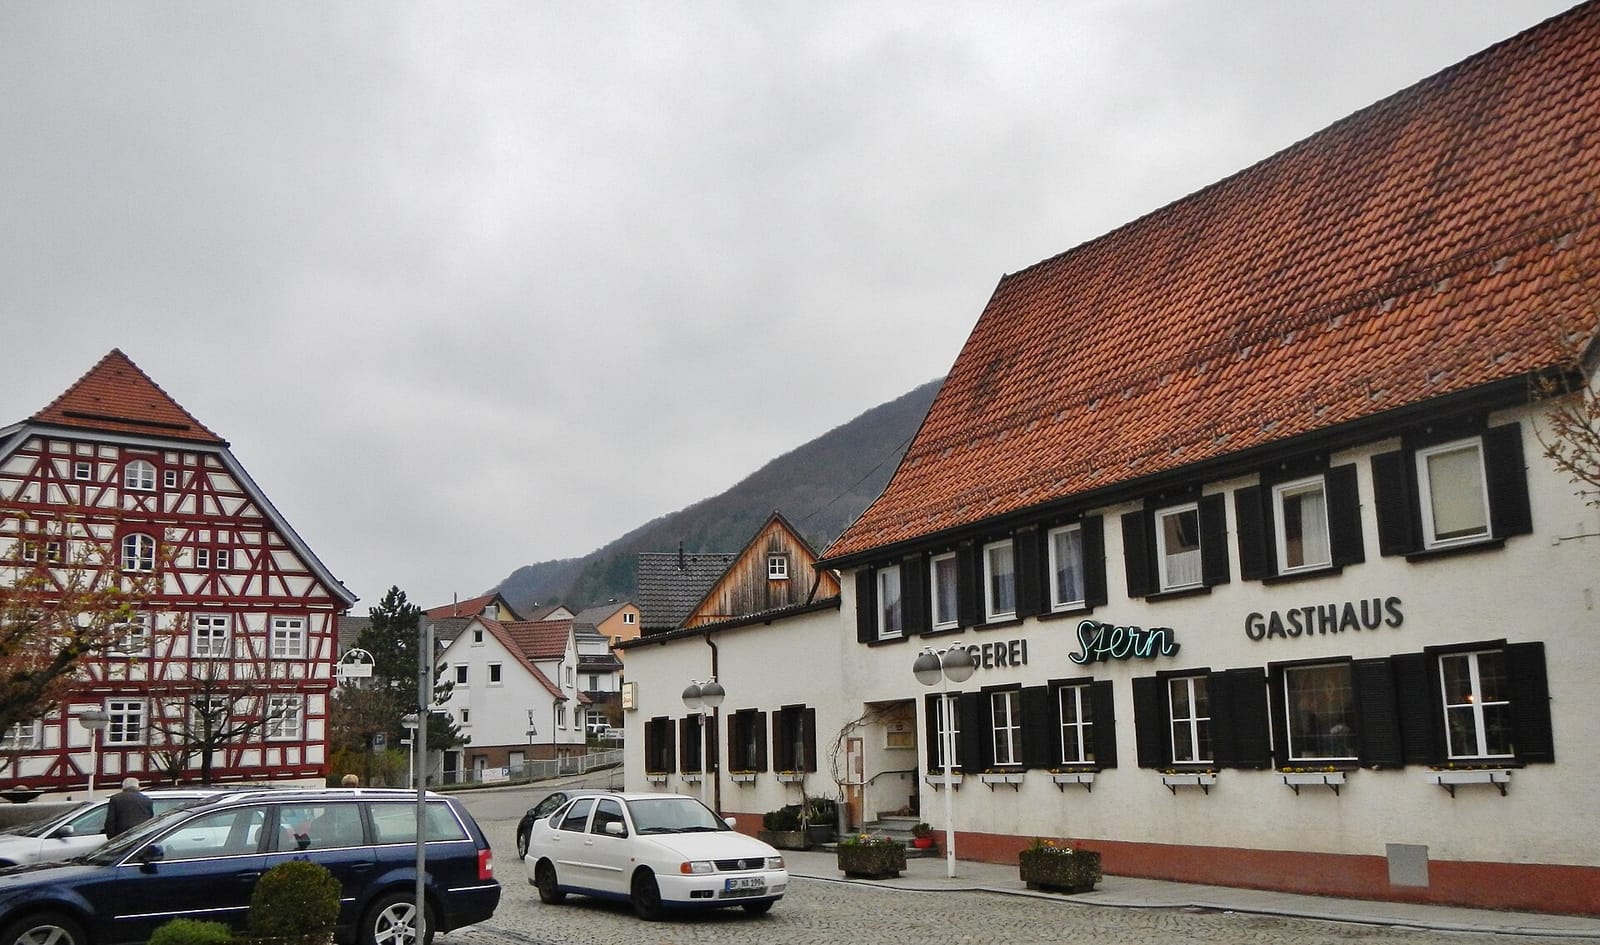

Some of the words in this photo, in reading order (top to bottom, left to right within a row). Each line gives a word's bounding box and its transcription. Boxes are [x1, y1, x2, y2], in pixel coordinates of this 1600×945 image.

[1245, 596, 1404, 641] GASTHAUS
[918, 638, 1028, 671] GEREI
[1068, 619, 1180, 665] Stern
